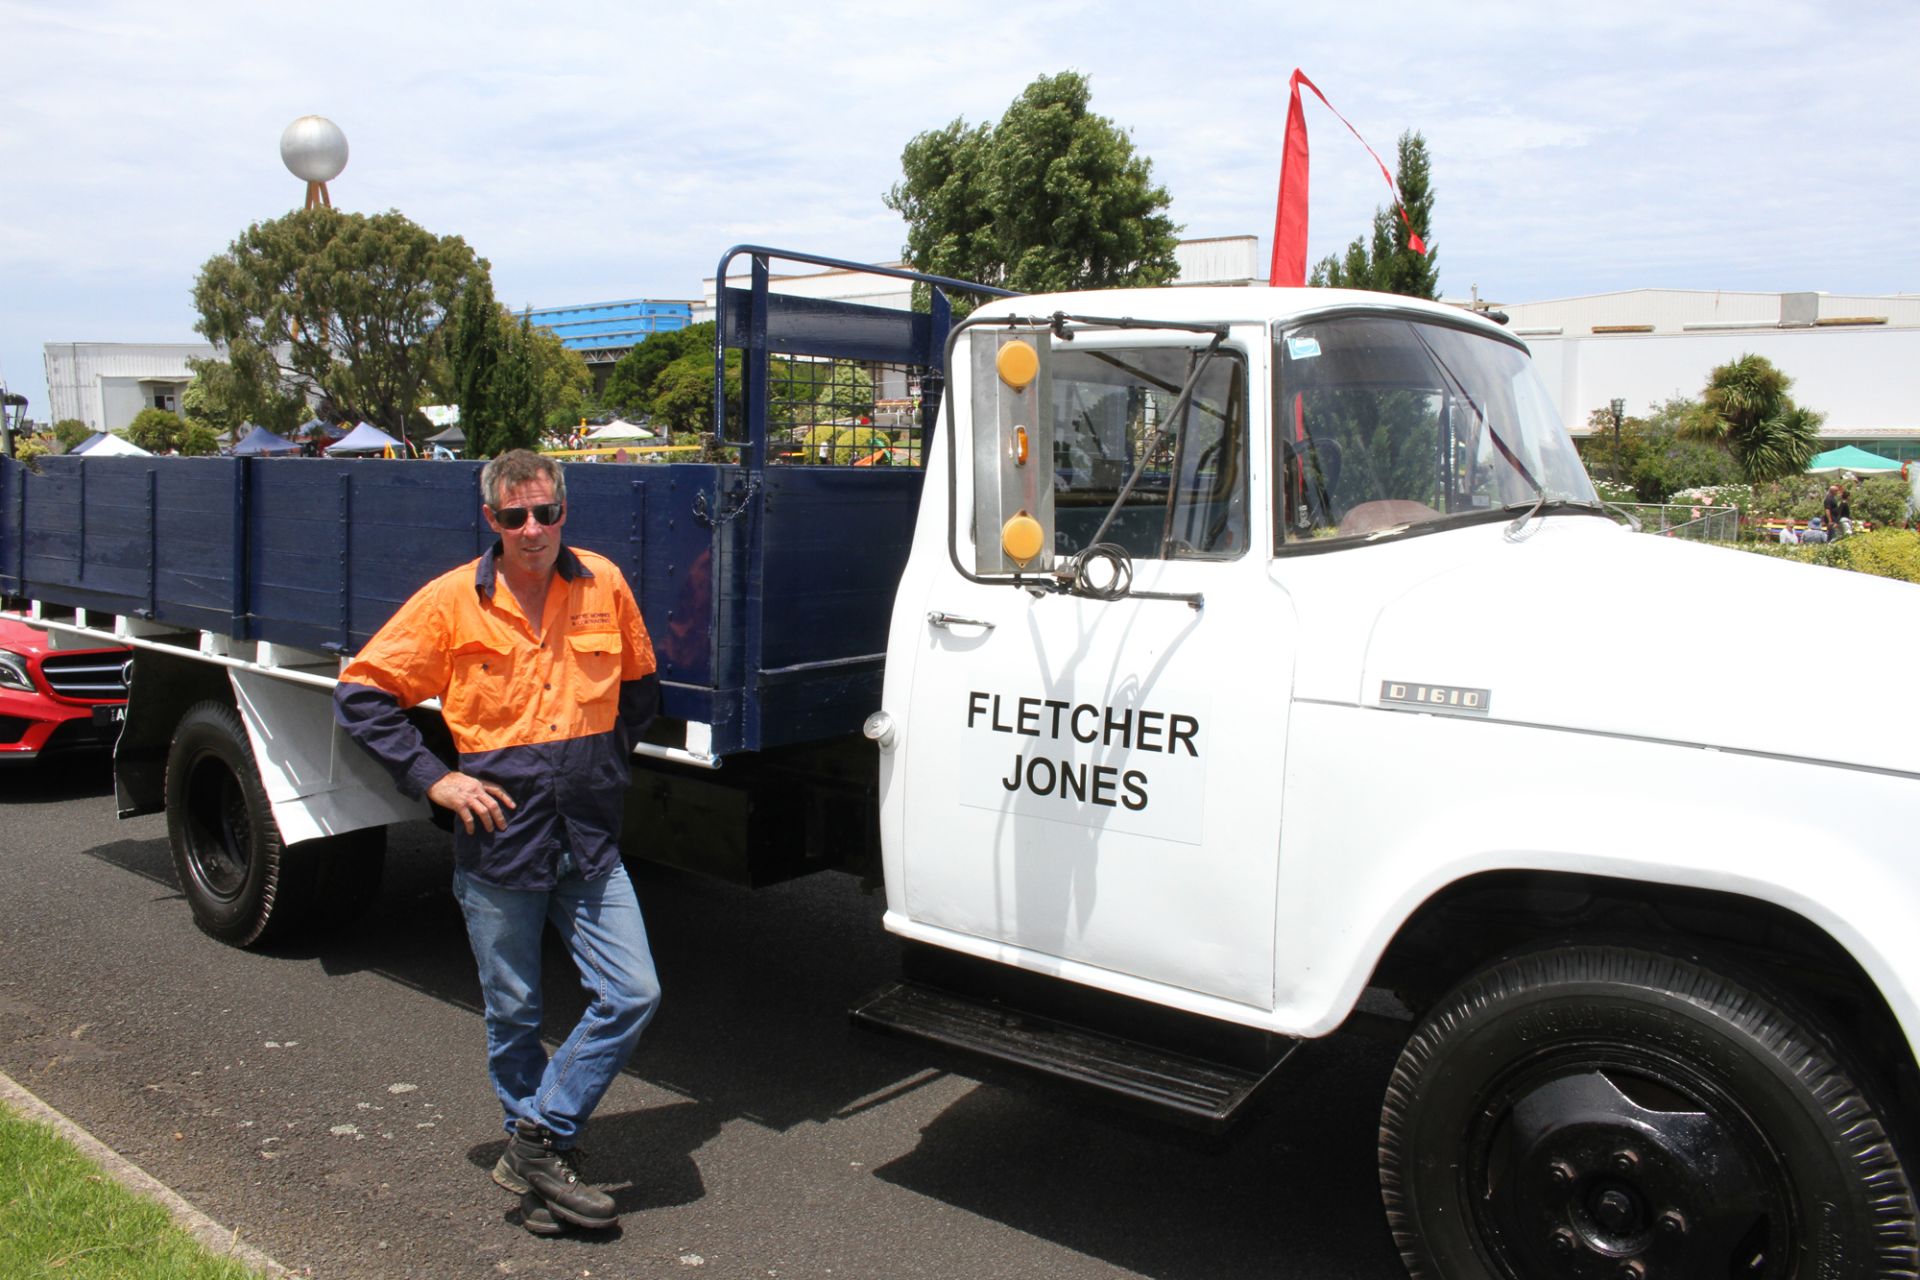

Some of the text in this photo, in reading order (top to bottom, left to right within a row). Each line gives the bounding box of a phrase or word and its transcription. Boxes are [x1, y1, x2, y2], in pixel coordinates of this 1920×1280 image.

[1390, 684, 1479, 707] D 1610
[968, 691, 1199, 757] FLETCHER
[1002, 755, 1148, 811] JONES
